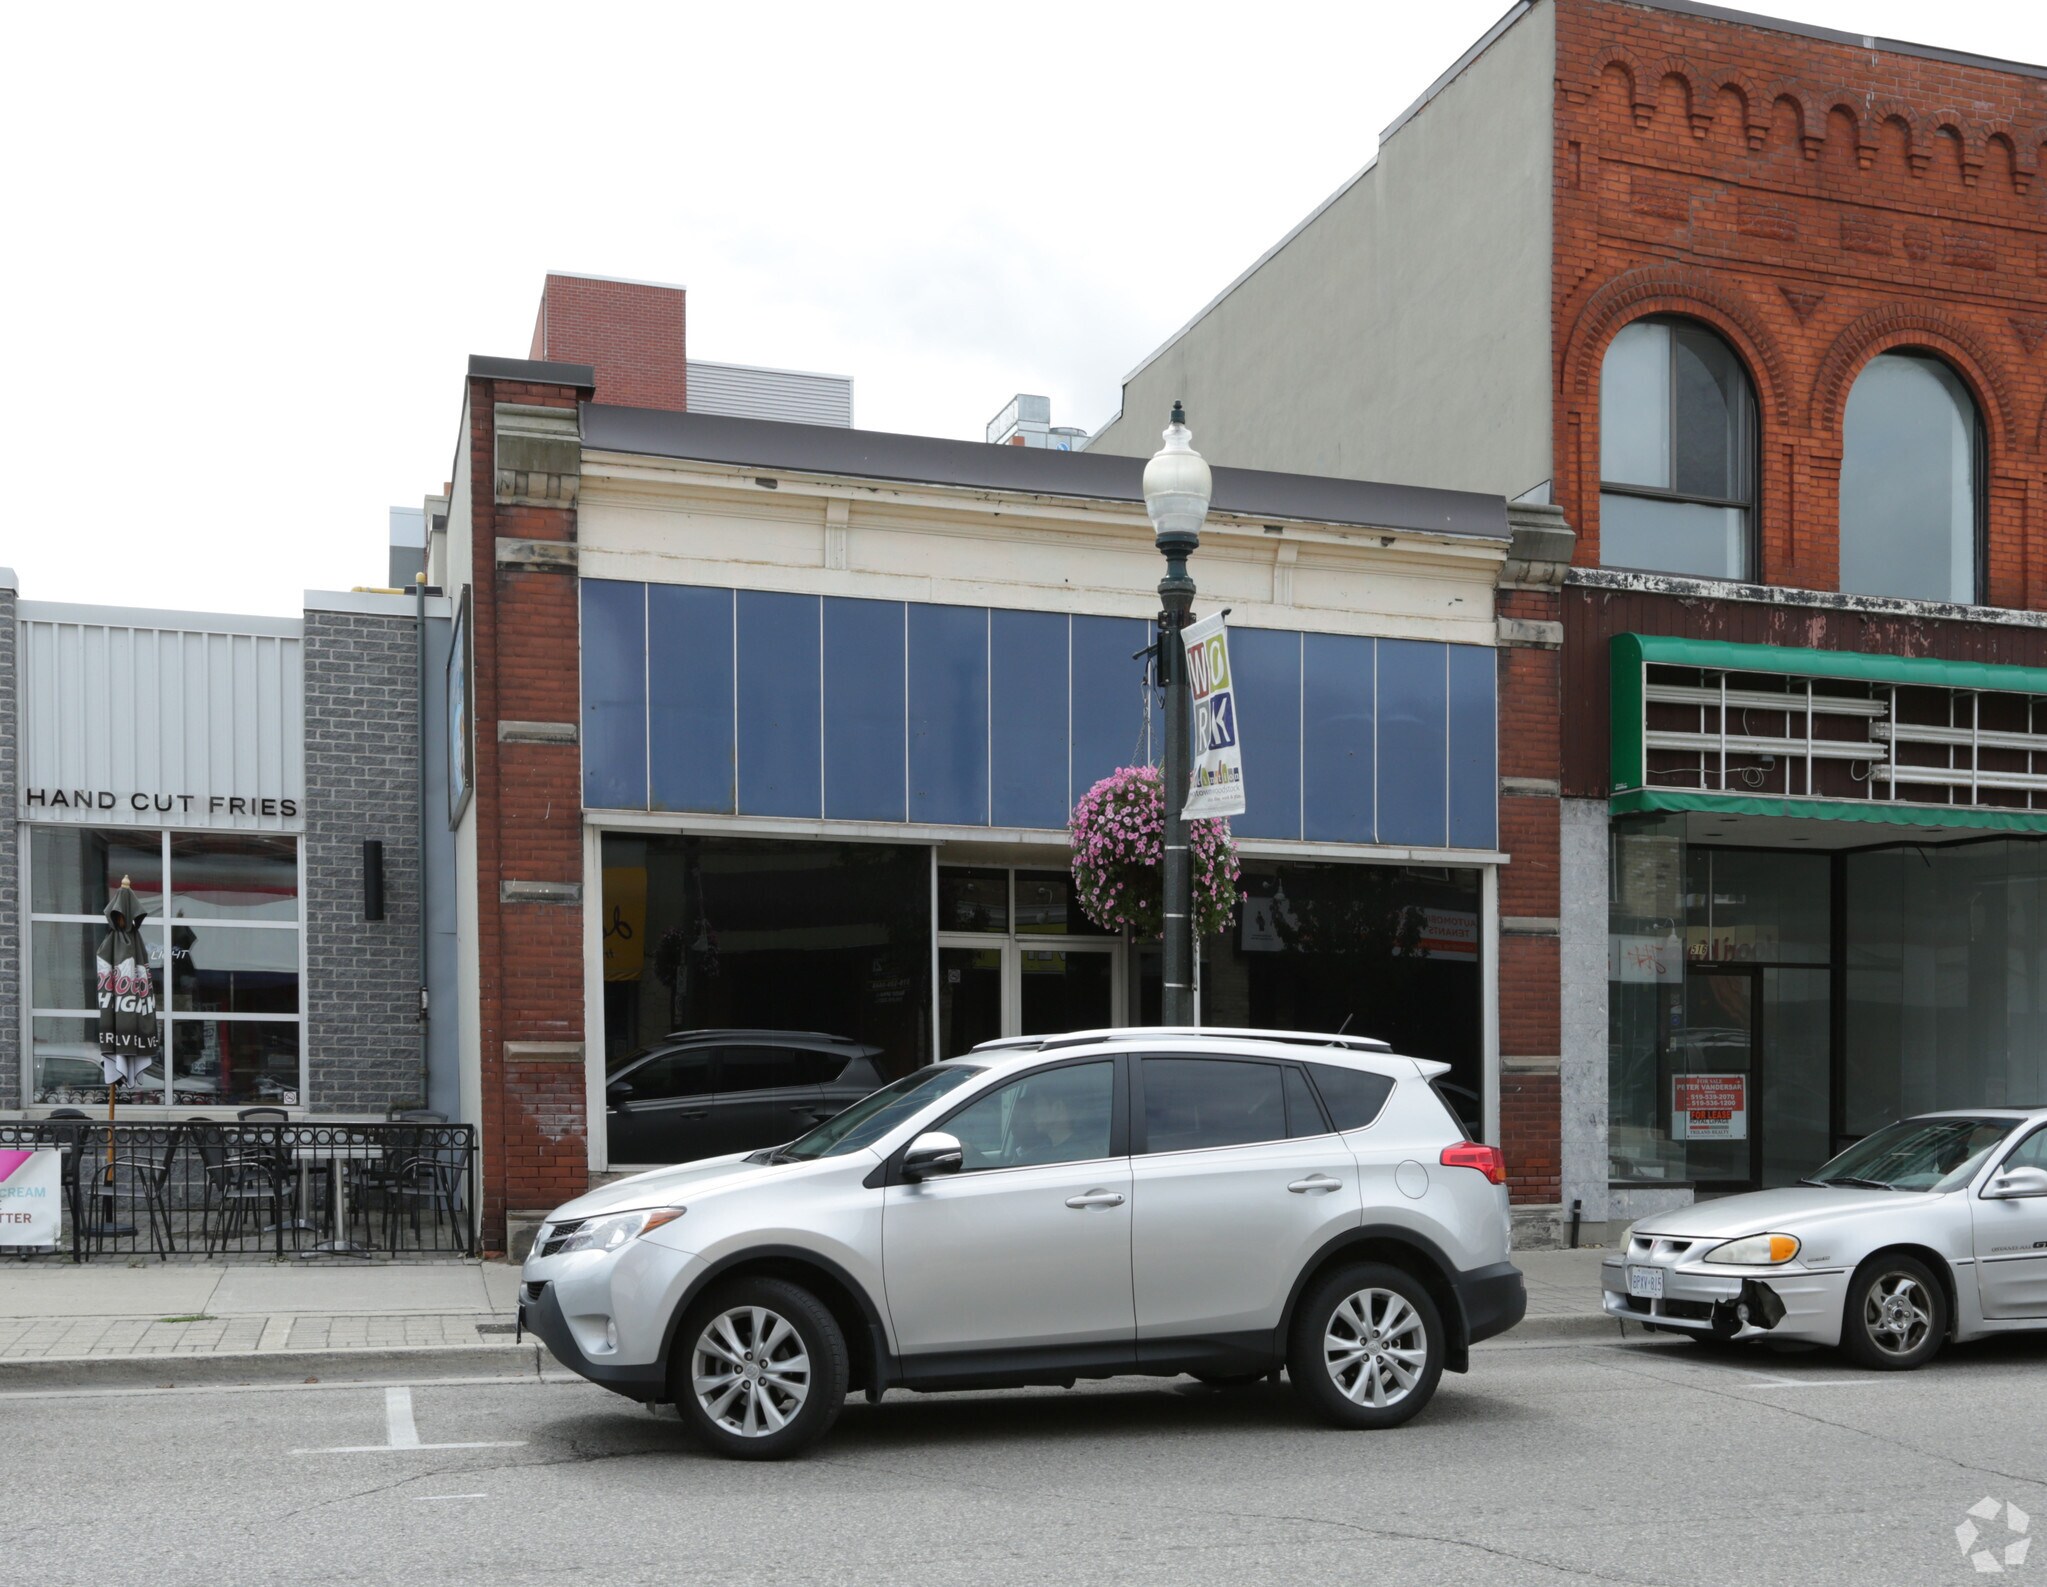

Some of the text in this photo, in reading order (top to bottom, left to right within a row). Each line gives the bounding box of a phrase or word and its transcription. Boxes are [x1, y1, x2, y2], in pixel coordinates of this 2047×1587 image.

[26, 788, 297, 817] HAND CUT FRIES
[1691, 1111, 1731, 1119] FOR LEASE
